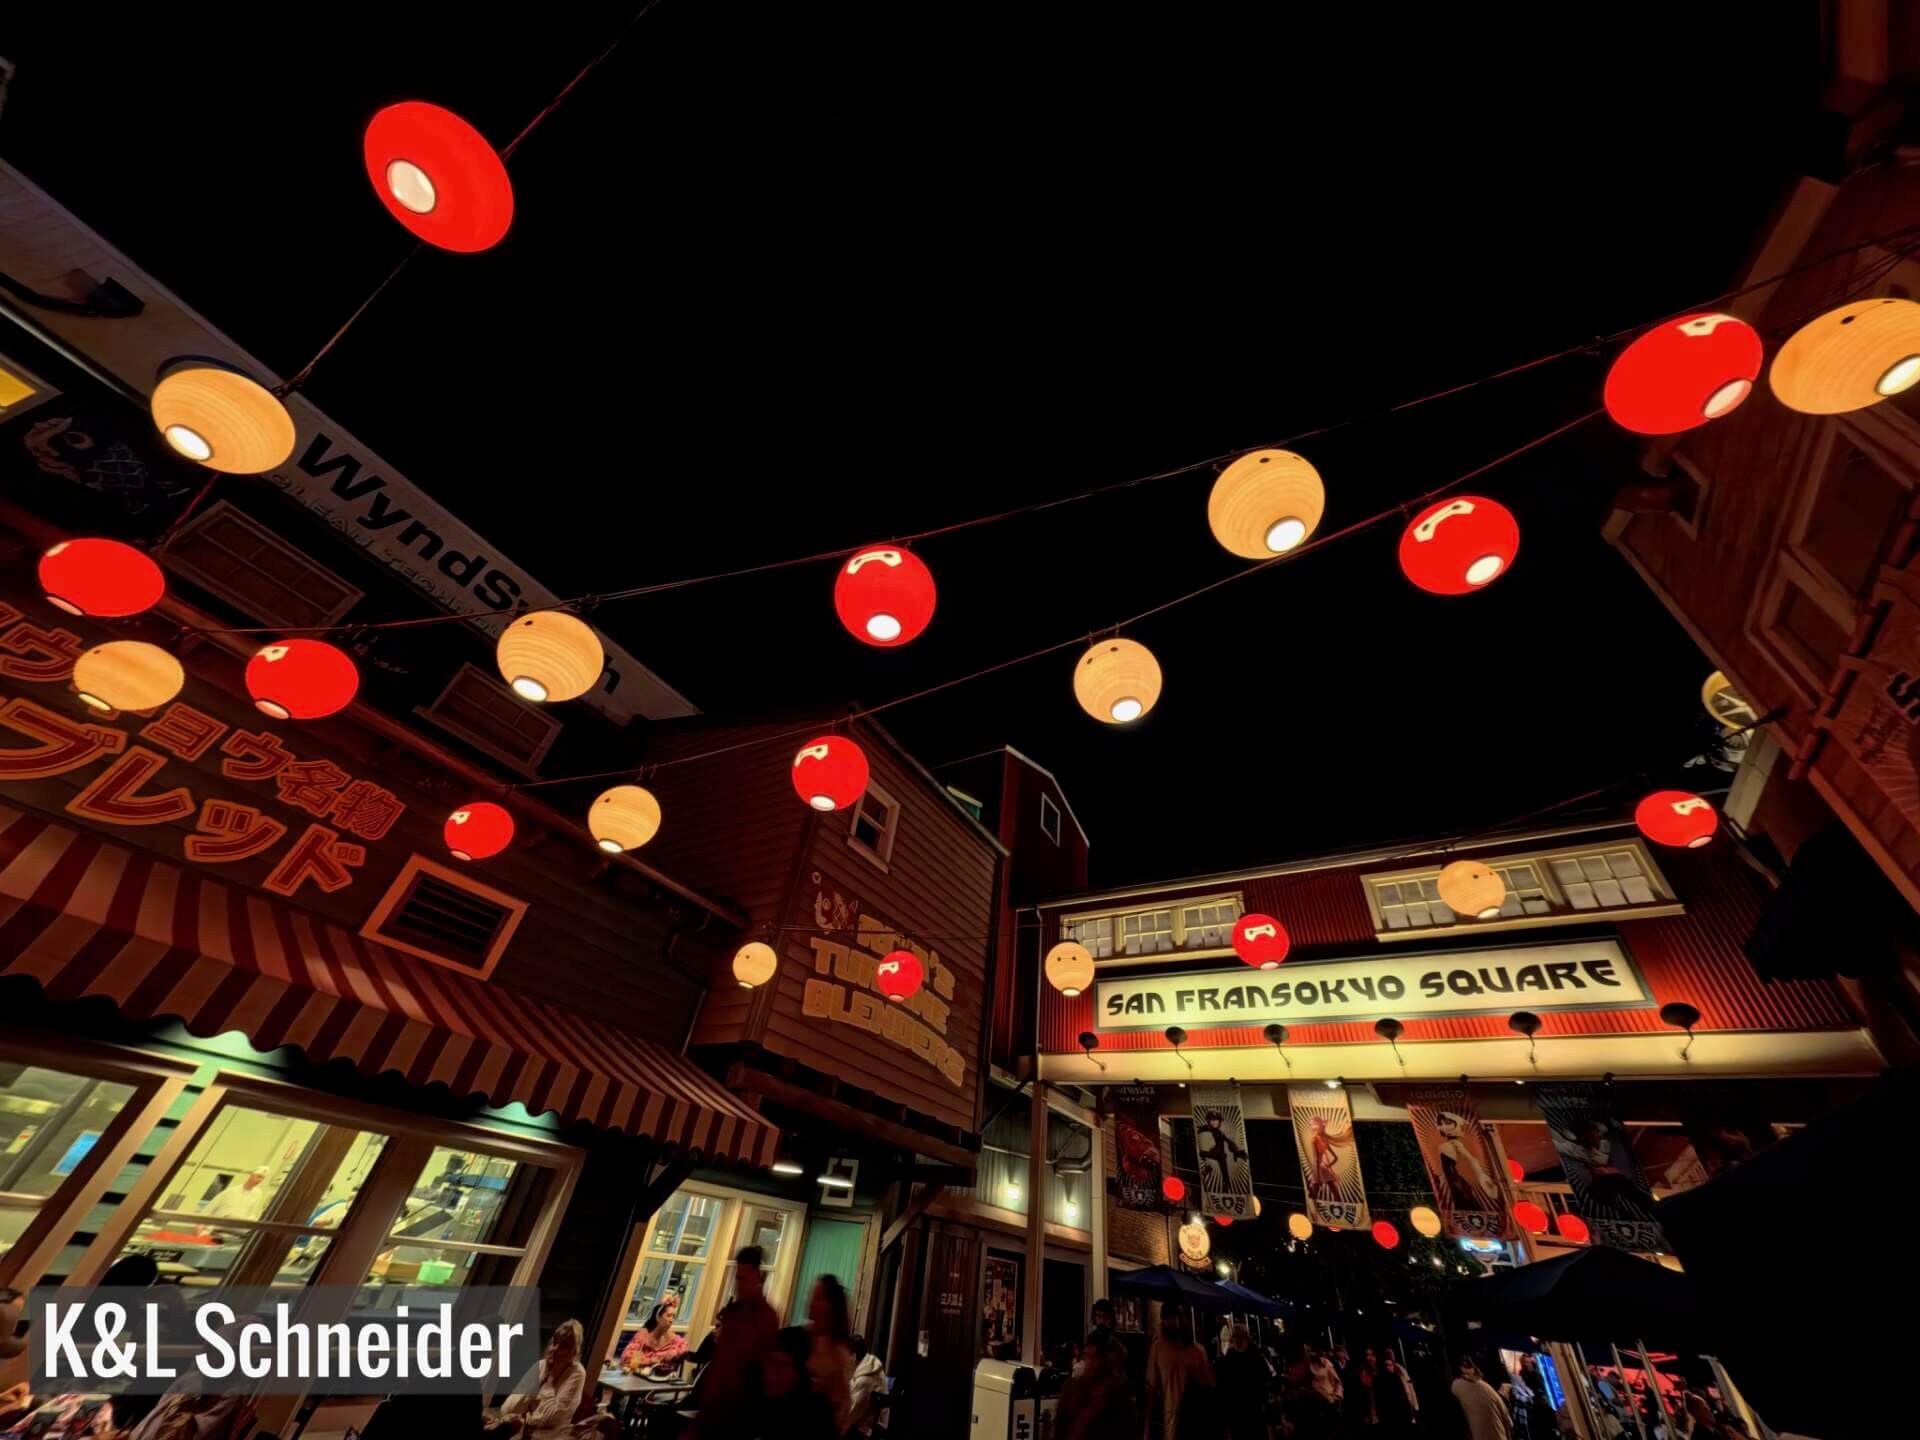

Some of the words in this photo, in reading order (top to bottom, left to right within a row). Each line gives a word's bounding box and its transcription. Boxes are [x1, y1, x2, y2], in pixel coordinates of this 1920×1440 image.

[1106, 992, 1166, 1016] SAN
[1176, 974, 1406, 1013] FRANSOKYO
[1420, 959, 1621, 998] SQUARE
[802, 978, 967, 1088] BLENDERS
